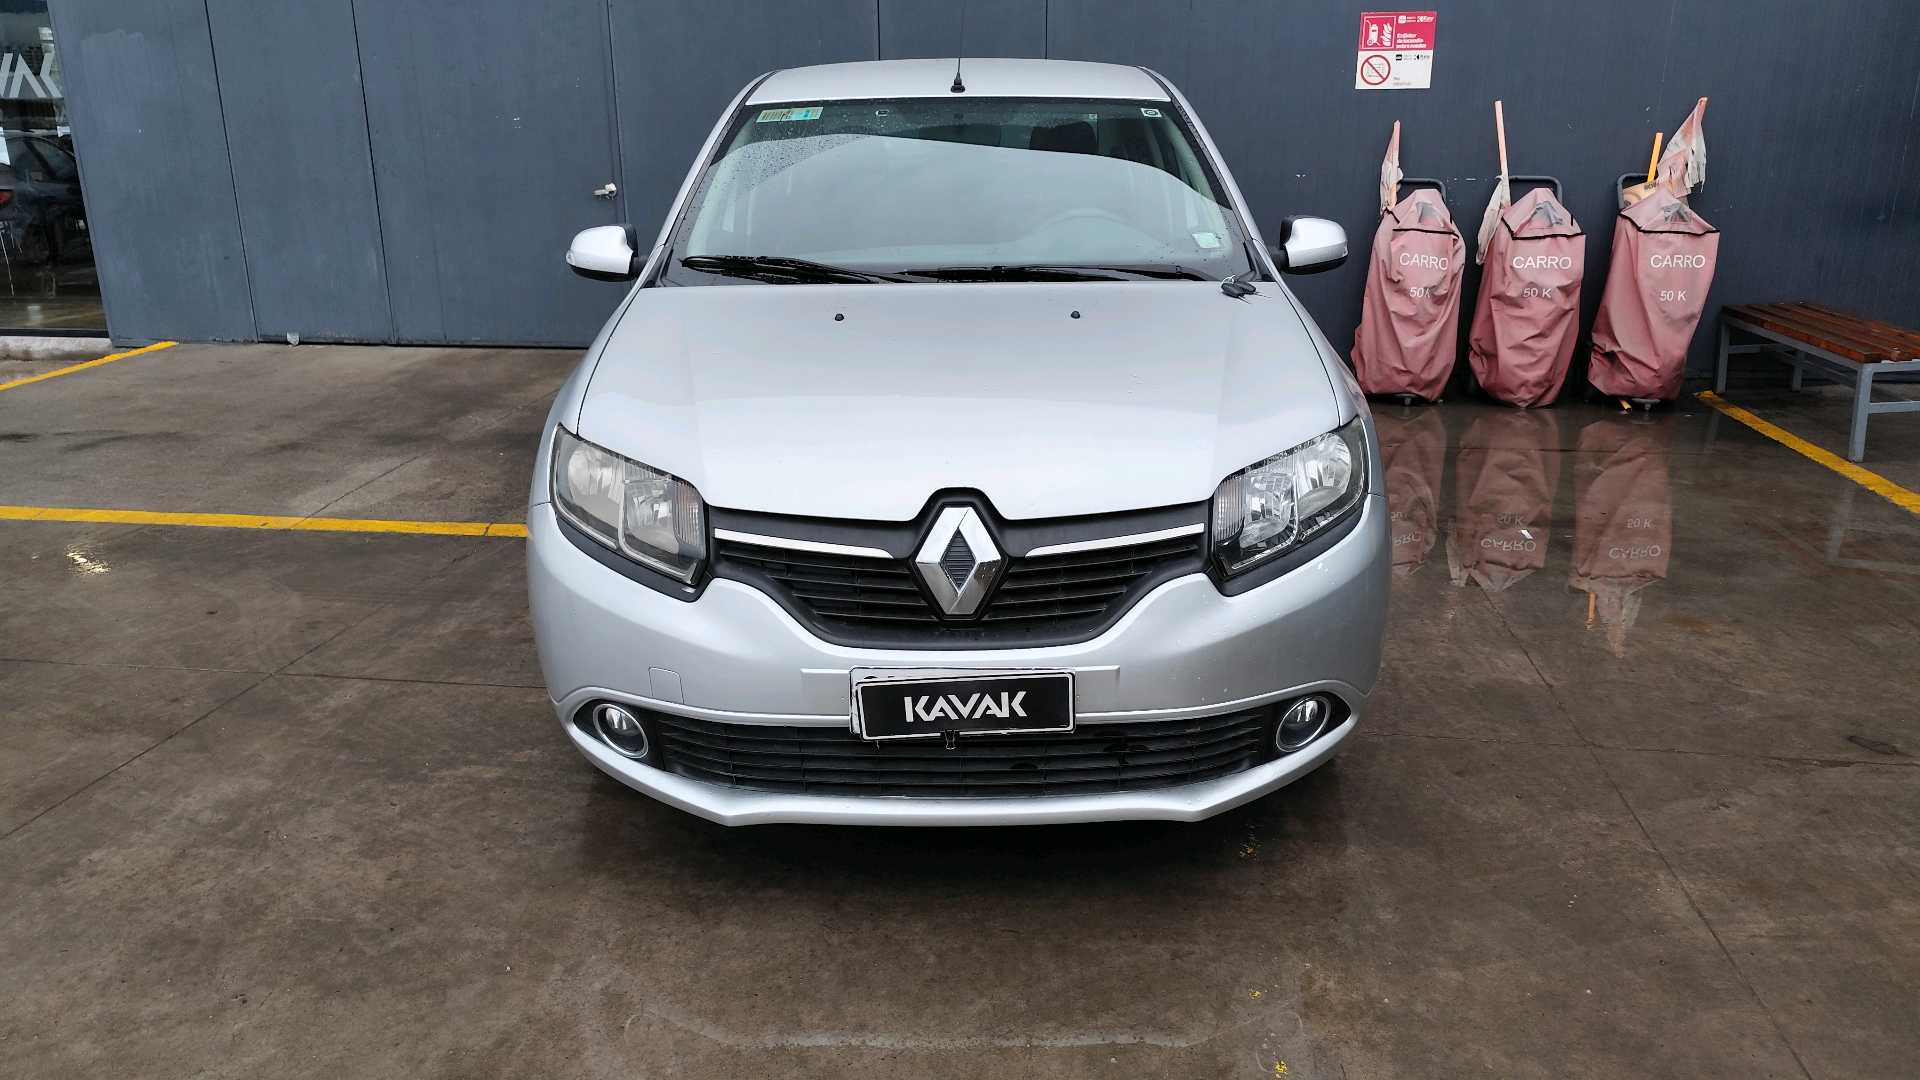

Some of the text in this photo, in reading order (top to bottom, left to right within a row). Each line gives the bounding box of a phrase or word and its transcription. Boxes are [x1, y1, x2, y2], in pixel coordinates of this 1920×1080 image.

[1399, 253, 1448, 270] CARRO
[1513, 255, 1571, 269] CARRO
[1650, 254, 1705, 268] CARRO
[1523, 287, 1552, 298] 50 K
[1659, 290, 1687, 302] 50 K
[904, 691, 1027, 722] KAVAK
